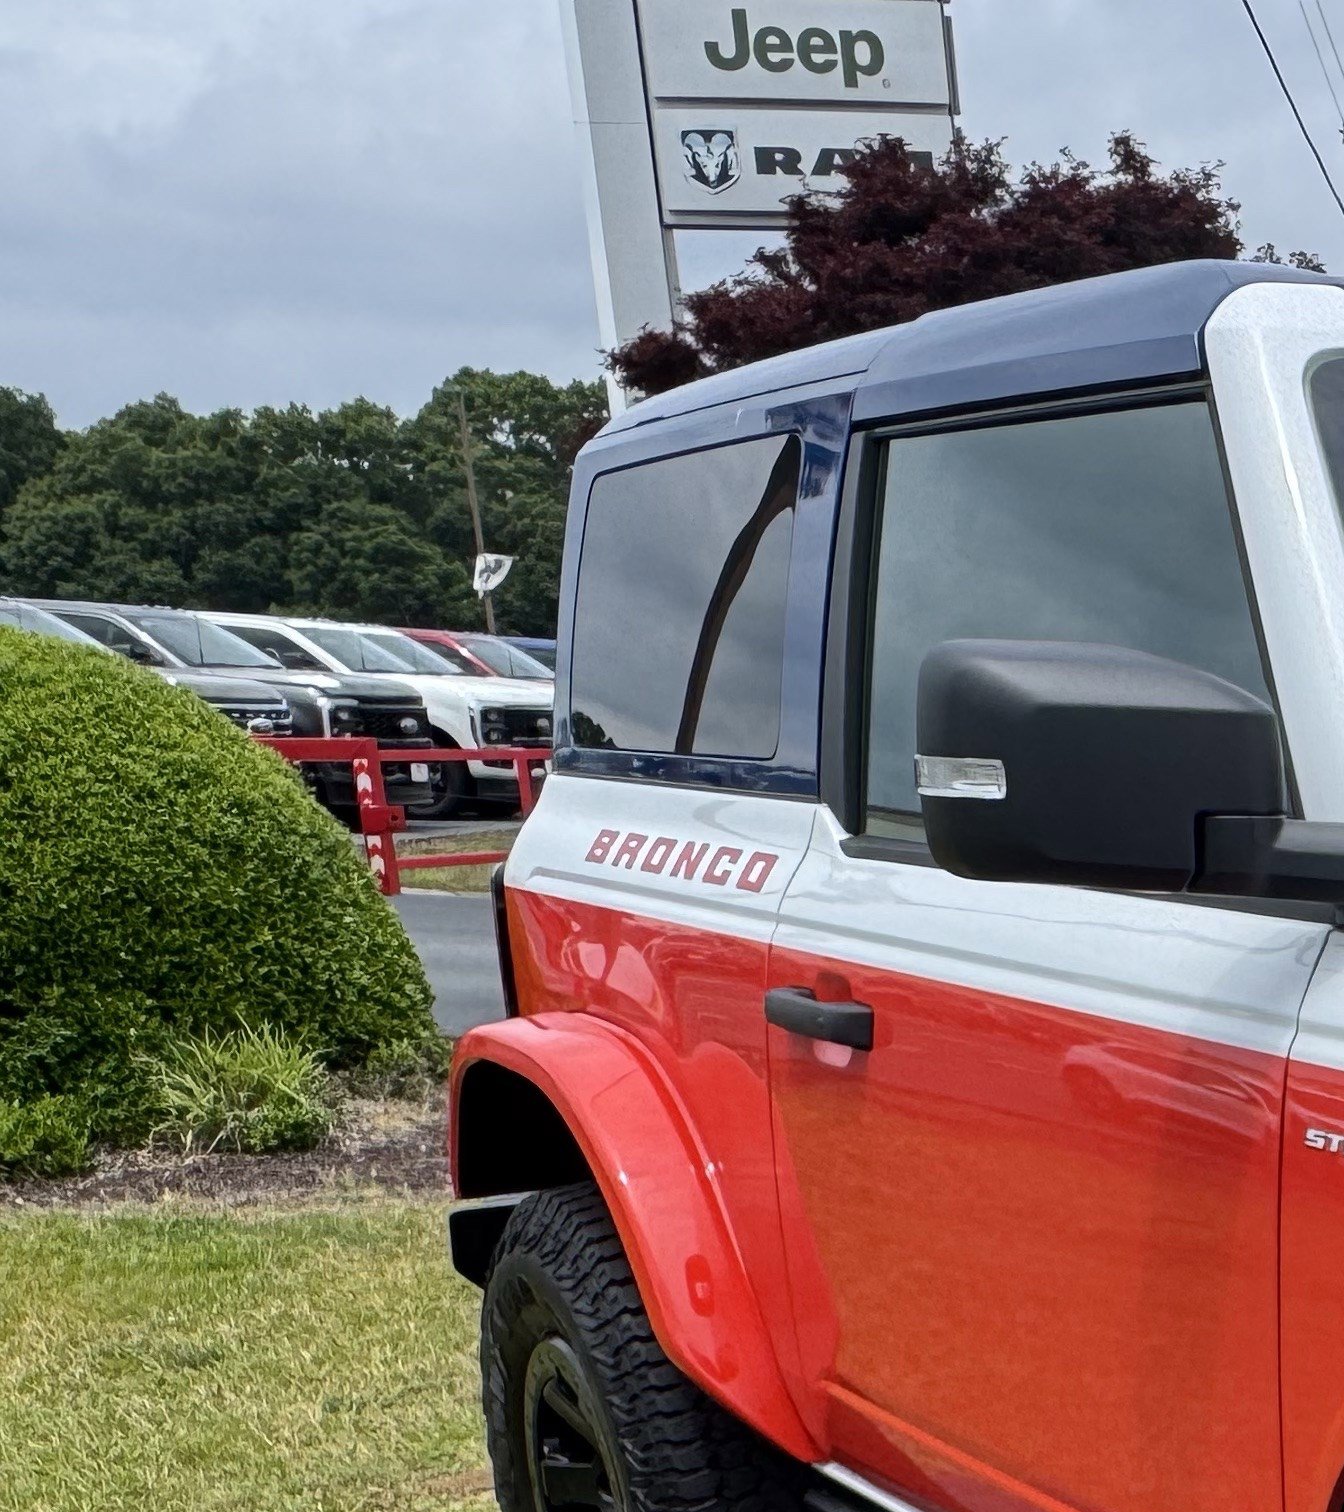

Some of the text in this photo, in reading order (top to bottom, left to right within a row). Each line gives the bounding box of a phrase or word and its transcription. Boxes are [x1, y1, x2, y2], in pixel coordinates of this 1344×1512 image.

[703, 8, 885, 88] Jeep
[754, 146, 935, 178] RA
[585, 829, 779, 893] BRONCO
